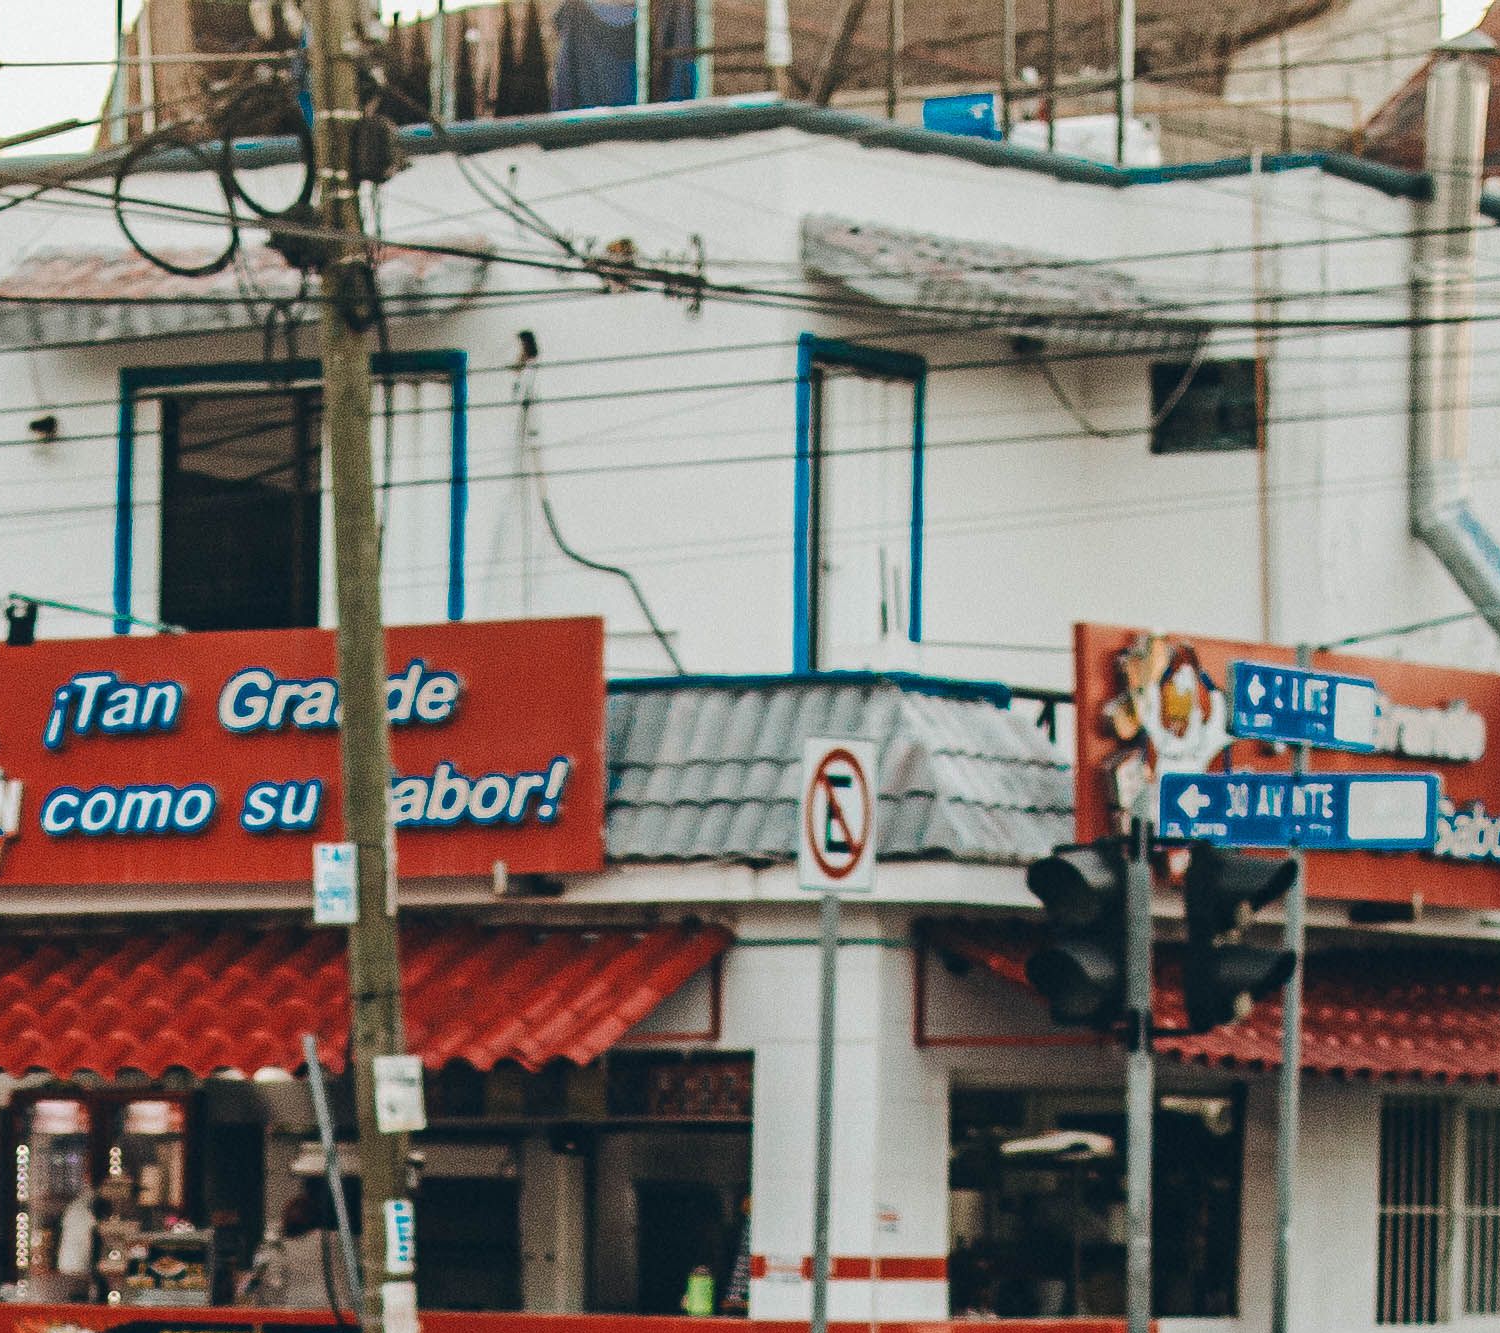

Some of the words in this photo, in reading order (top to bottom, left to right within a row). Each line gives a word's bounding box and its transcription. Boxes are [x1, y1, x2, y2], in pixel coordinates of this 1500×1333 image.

[44, 672, 184, 748] ¡Tan
[217, 658, 463, 733] Grade
[40, 784, 218, 836] como
[240, 778, 323, 829] su
[389, 755, 574, 824] abor!
